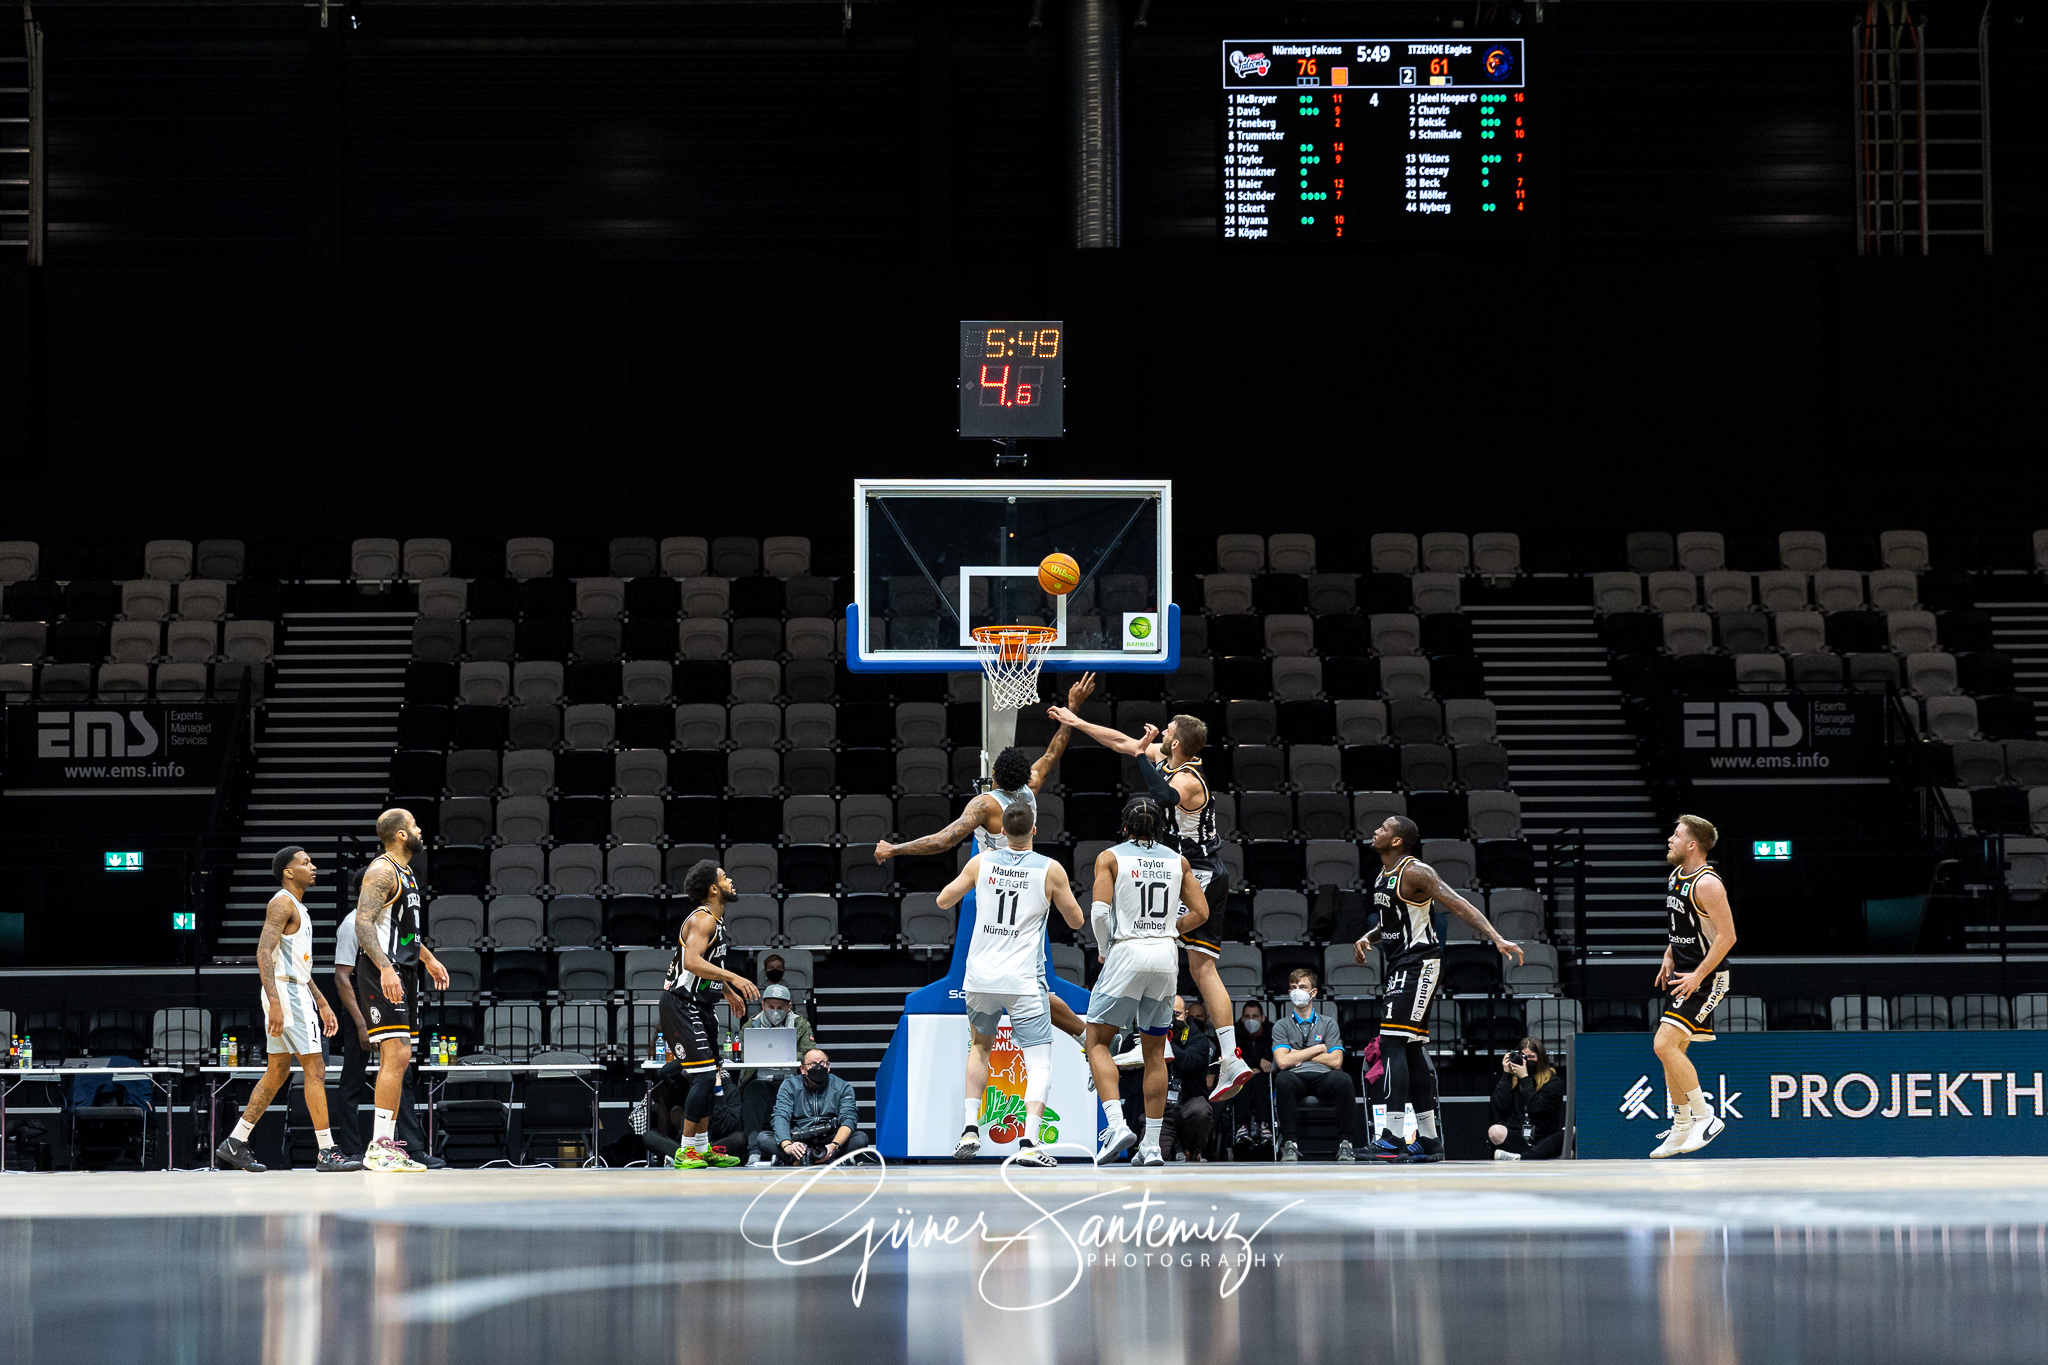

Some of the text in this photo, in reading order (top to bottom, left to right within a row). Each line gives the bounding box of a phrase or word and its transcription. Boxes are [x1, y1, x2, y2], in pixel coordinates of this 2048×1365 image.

[1272, 45, 1311, 57] Nürnberg
[1312, 45, 1342, 55] Falcons
[1357, 45, 1390, 62] 5:49
[1408, 44, 1472, 56] ITZEHOE Eagles
[1297, 59, 1317, 75] 76
[1430, 58, 1448, 75] 61
[1403, 69, 1412, 83] 2
[1228, 94, 1277, 106] 1 McBrayer
[1333, 94, 1342, 103] 11
[1370, 93, 1379, 107] 4
[1409, 93, 1414, 103] 1
[1417, 93, 1439, 104] Jaleel
[1440, 93, 1469, 105] Hooper
[1514, 93, 1524, 102] 16
[1228, 106, 1260, 116] 3 Davis
[1335, 106, 1341, 115] 9
[1409, 105, 1450, 115] 2 Charvis
[1228, 118, 1276, 130] 7 Feneberg
[1335, 118, 1340, 127] 2
[1409, 117, 1446, 127] 7 Boksic
[1516, 117, 1522, 126] 6
[1228, 131, 1285, 140] 8 Trummeter
[1410, 129, 1462, 139] 9 Schmikale
[1515, 129, 1524, 138] 10
[1228, 142, 1259, 152] 9 Price
[1333, 142, 1343, 151] 14
[1224, 155, 1264, 166] 10 Taylor
[1335, 155, 1341, 164] 9
[1406, 153, 1450, 163] 13 Viktors
[1517, 153, 1522, 162] 7
[1224, 167, 1276, 176] 11 Maukner
[1405, 166, 1449, 178] 26 Ceesay
[1224, 179, 1263, 189] 13 Maier
[1334, 179, 1344, 188] 12
[1406, 177, 1440, 187] 30 Beck
[1517, 177, 1523, 187] 7
[1225, 191, 1275, 200] 14 Schröder
[1336, 191, 1342, 200] 7
[1406, 190, 1447, 199] 42 Möller
[1516, 190, 1525, 198] 11
[1225, 203, 1265, 213] 19 Eckert
[1406, 202, 1451, 214] 44 Nyberg
[1517, 202, 1523, 211] 4
[1225, 216, 1268, 228] 24 Nyama
[1334, 215, 1344, 225] 10
[1225, 227, 1267, 239] 25 Köpple
[1336, 227, 1342, 236] 2
[986, 329, 1059, 358] 5:49
[980, 364, 1031, 407] 4.6
[1814, 701, 1846, 712] Experts
[171, 711, 203, 722] Experts
[1814, 714, 1855, 725] Managed
[171, 723, 212, 734] Managed
[1814, 726, 1851, 736] Services
[171, 735, 208, 746] Services
[1710, 752, 1830, 768] www.ems.info
[64, 762, 186, 778] www.ems.info
[1137, 859, 1164, 869] Taylor
[992, 865, 1029, 879] Maukner
[1135, 881, 1169, 918] 10
[995, 888, 1019, 926] 11
[1386, 1001, 1394, 1019] 1
[1769, 1072, 2044, 1117] PROJEKTH
